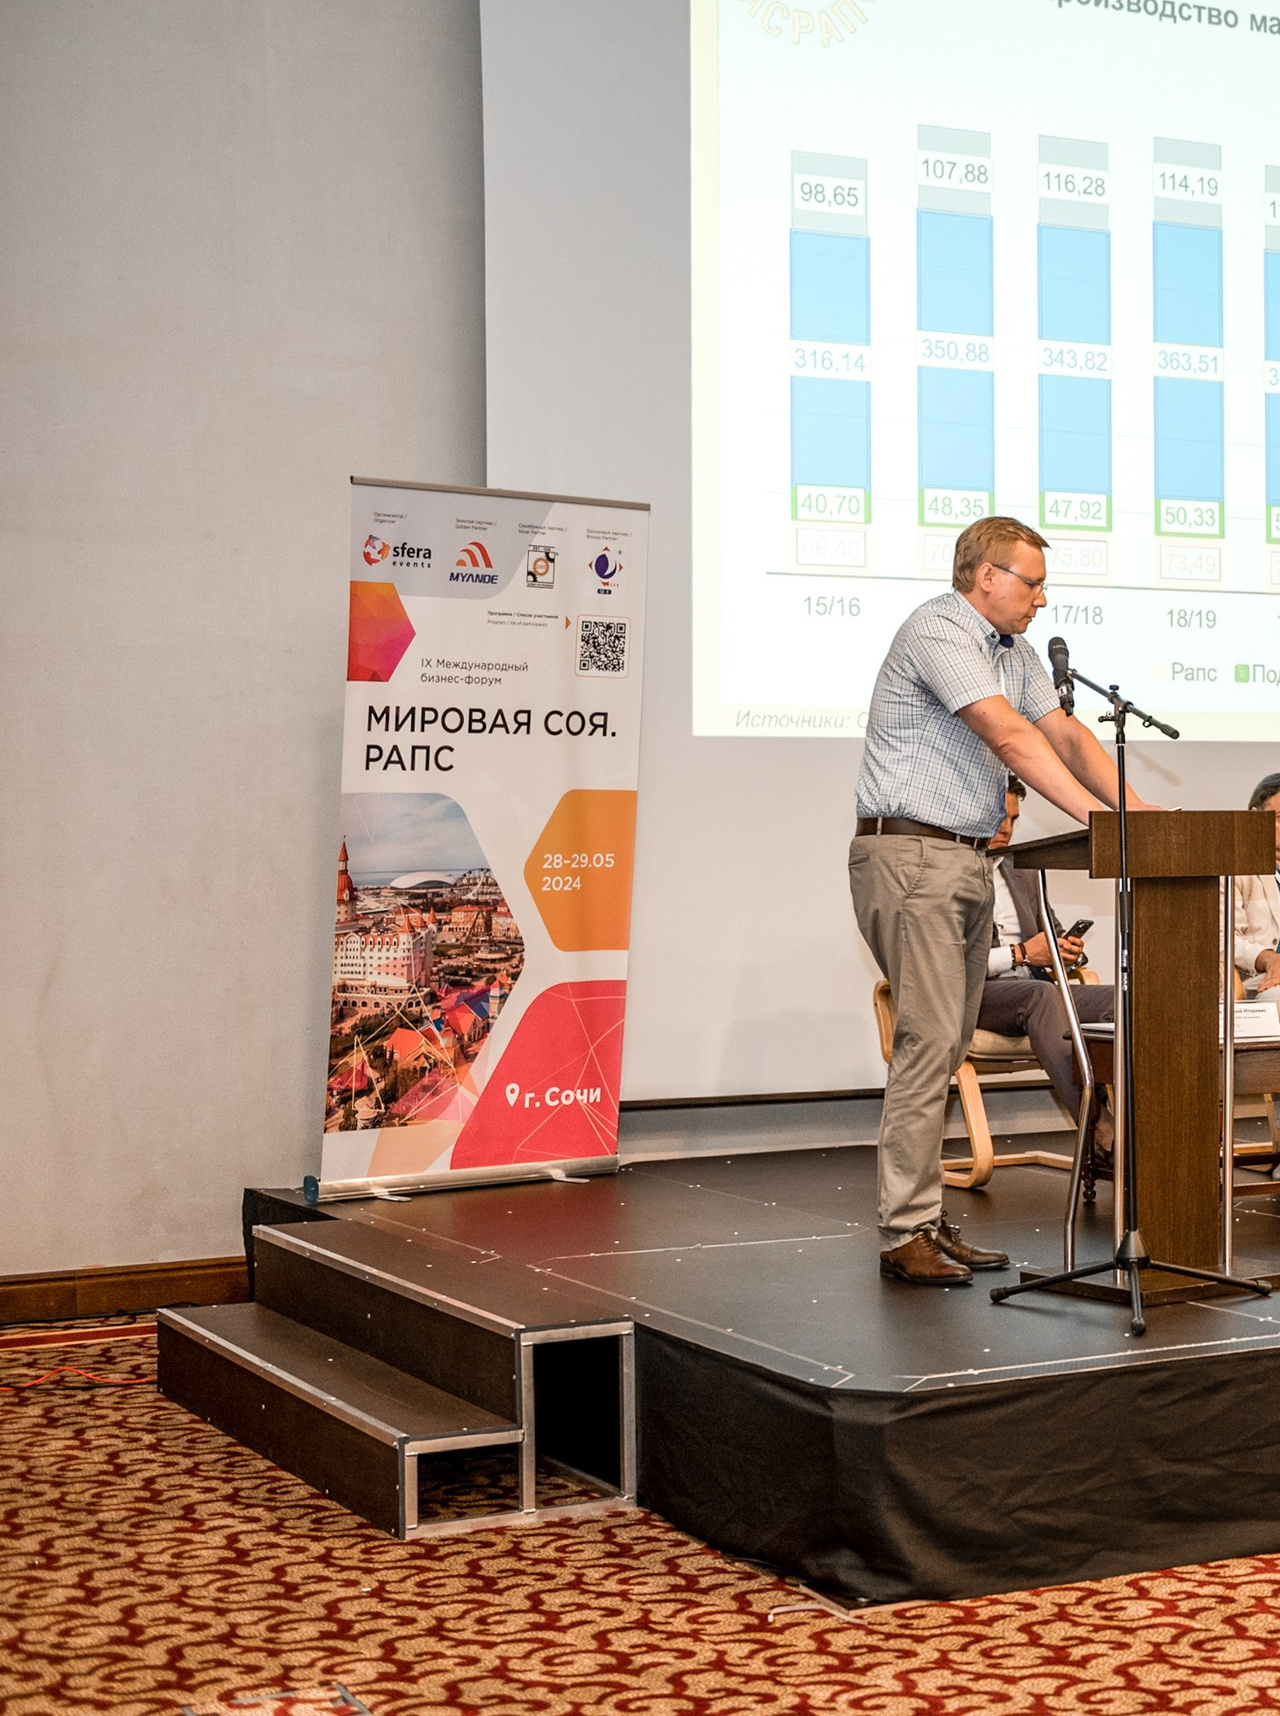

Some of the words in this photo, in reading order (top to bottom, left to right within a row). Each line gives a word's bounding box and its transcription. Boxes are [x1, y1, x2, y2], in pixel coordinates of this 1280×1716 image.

[1057, 0, 1239, 29] зводство
[799, 181, 859, 208] 98,65
[921, 158, 989, 186] 107,88
[1042, 170, 1107, 198] 116,28
[1158, 170, 1220, 197] 114,19
[793, 347, 866, 375] 316,14
[920, 337, 990, 365] 350,88
[1042, 347, 1109, 373] 343,82
[1157, 348, 1220, 376] 363,51
[800, 493, 861, 517] 40,70
[928, 496, 985, 520] 48,35
[1049, 499, 1103, 522] 47,92
[1164, 505, 1216, 530] 50,33
[392, 542, 432, 559] sfera
[392, 560, 431, 569] events
[1165, 551, 1217, 575] 73,49
[449, 571, 499, 585] MYANDE
[803, 595, 861, 617] 15/16
[1051, 603, 1104, 626] 17/18
[1166, 608, 1217, 629] 18/19
[421, 658, 433, 669] IX
[436, 657, 529, 672] Международный
[1171, 662, 1218, 684] Рапс
[420, 673, 502, 686] бизнес-форум
[367, 705, 532, 735] МИРОВАЯ
[543, 710, 617, 737] СОЯ.
[735, 710, 851, 728] Источники:
[365, 744, 455, 772] РАПС
[542, 852, 615, 870] 28-29.05
[541, 876, 582, 892] 2024
[524, 1092, 541, 1109] г.
[545, 1085, 602, 1107] Сочи
